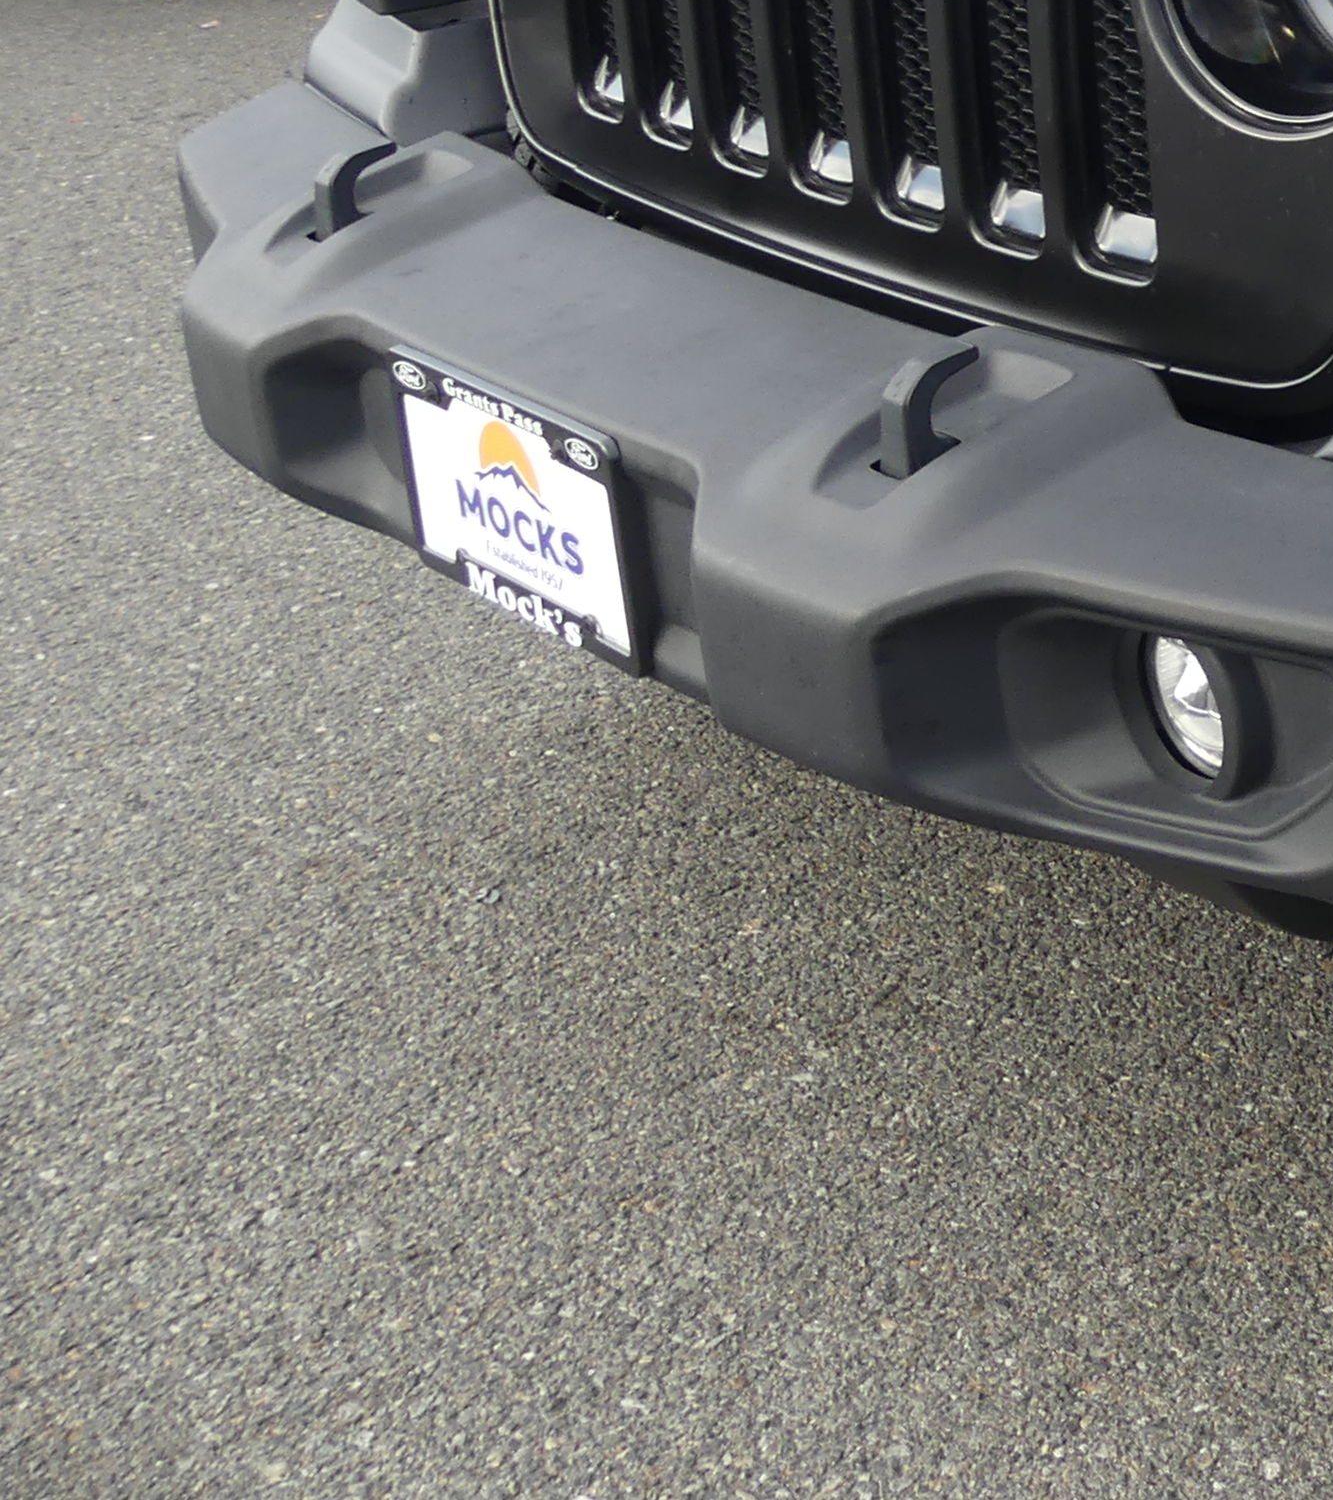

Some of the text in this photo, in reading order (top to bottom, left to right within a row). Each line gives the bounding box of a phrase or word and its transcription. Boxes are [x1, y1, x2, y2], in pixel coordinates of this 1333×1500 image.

[442, 378, 543, 436] Grants Pass
[455, 478, 584, 576] MOCKS
[464, 562, 583, 647] Mock's
